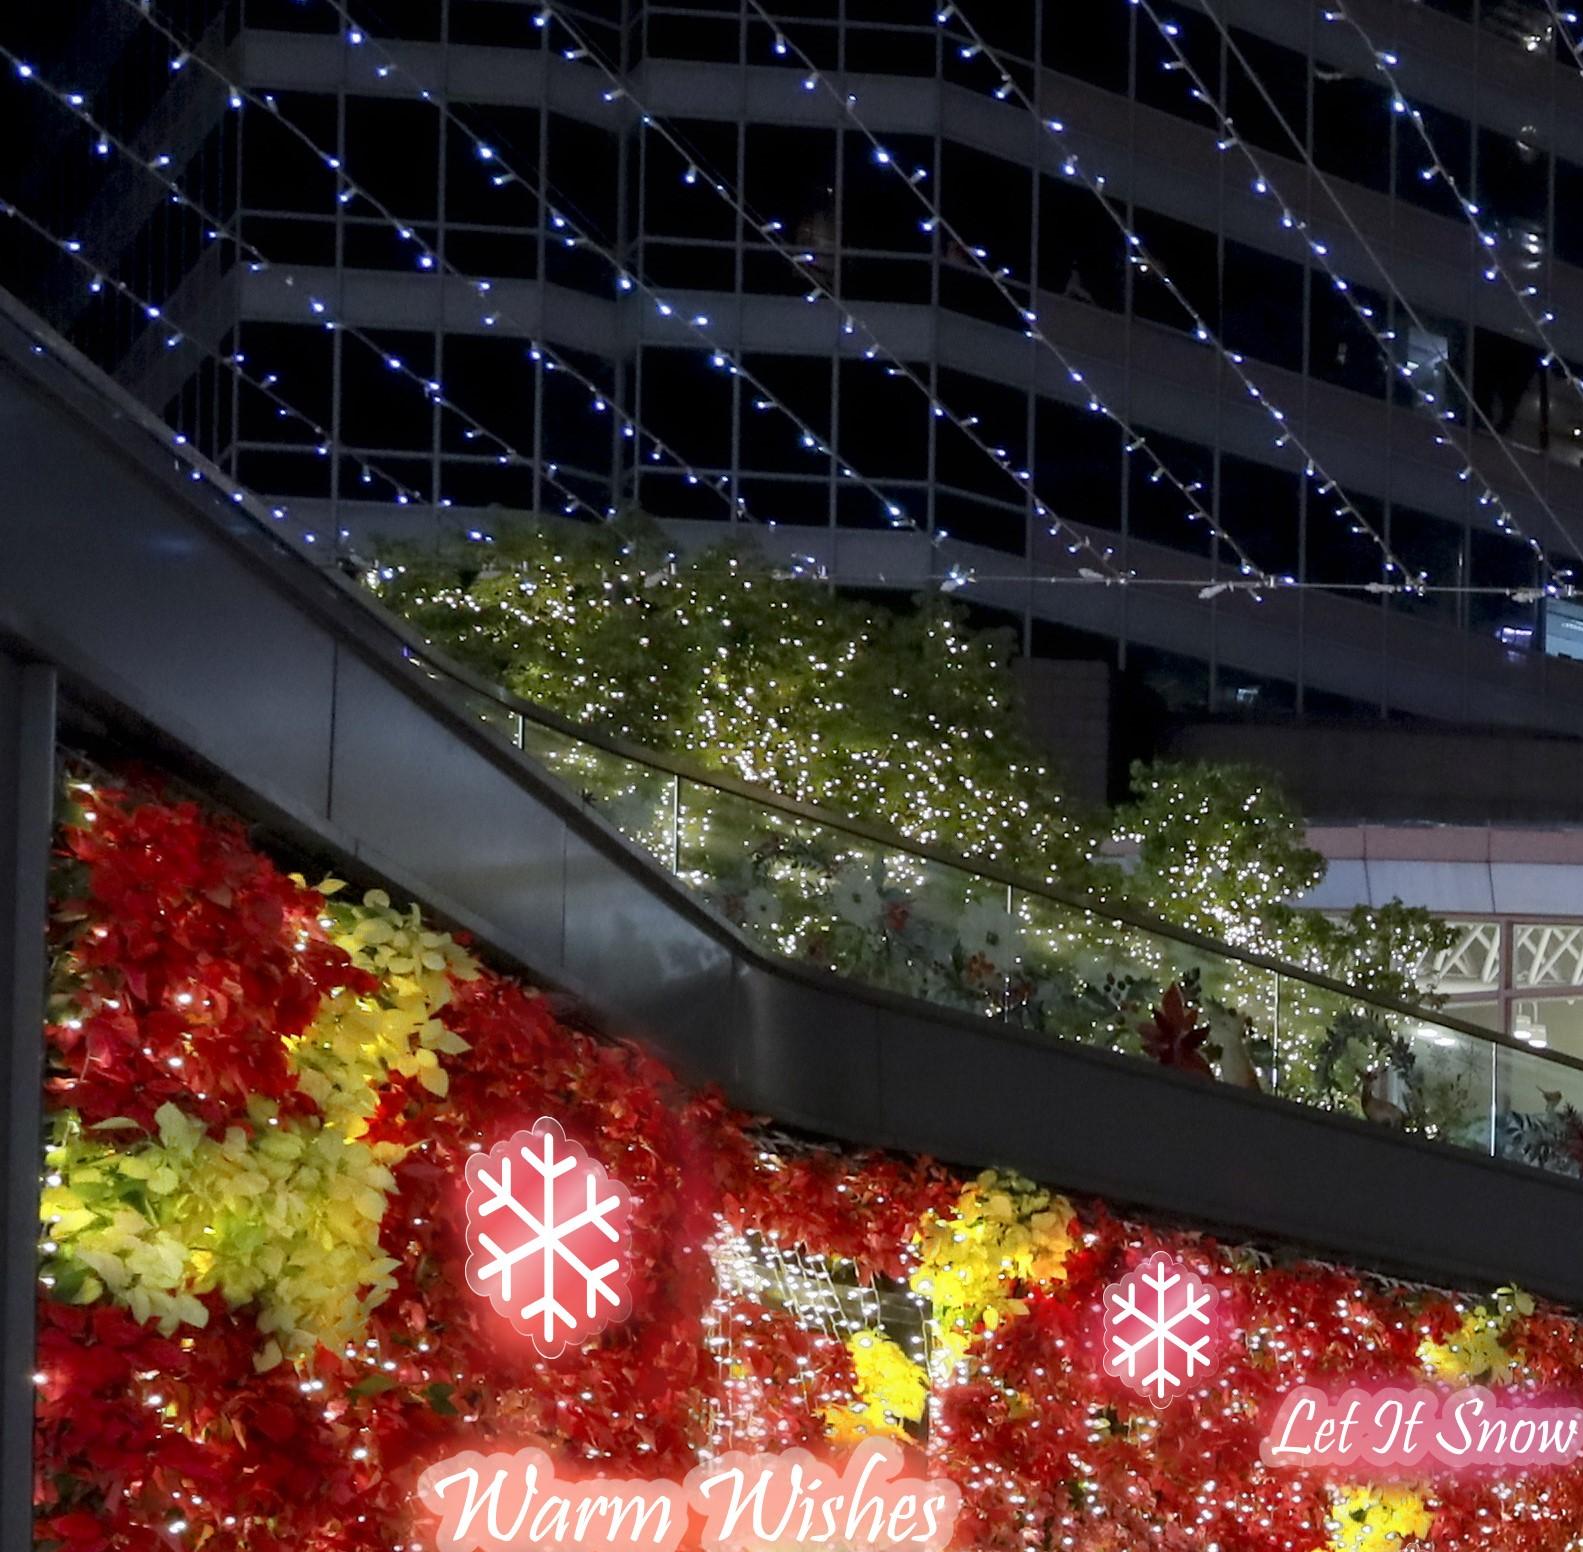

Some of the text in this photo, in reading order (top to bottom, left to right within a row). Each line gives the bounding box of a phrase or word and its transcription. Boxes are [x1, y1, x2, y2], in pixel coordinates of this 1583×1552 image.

[1271, 1397, 1579, 1456] Let It Snow
[433, 1451, 946, 1544] Warm Wishes
